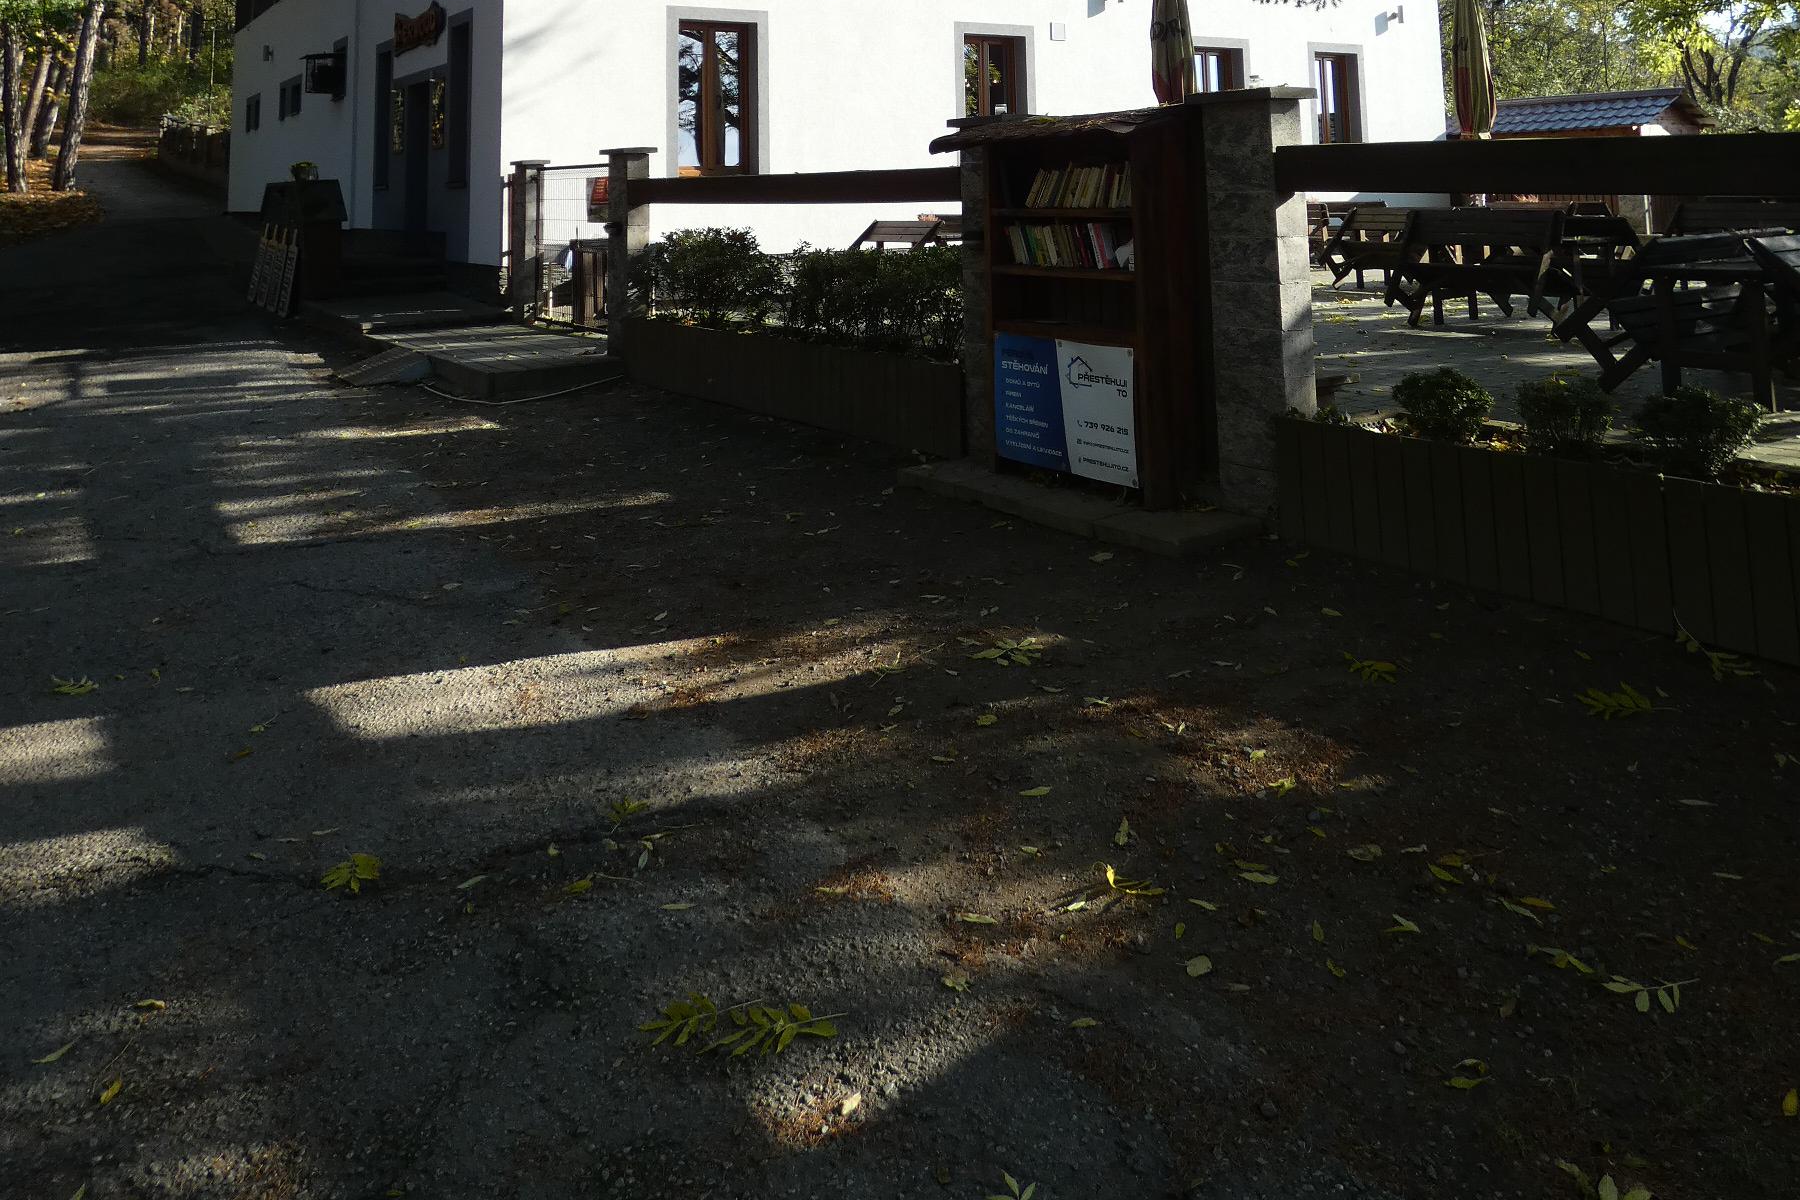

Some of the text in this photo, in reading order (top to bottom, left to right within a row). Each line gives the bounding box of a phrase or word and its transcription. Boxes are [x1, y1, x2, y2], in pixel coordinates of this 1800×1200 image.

[1001, 360, 1048, 375] STĚHOVÁNÍ
[1077, 372, 1128, 388] PŘESTĚHUJI
[1117, 389, 1127, 398] TO
[1084, 420, 1098, 429] 739
[1100, 423, 1114, 433] 926
